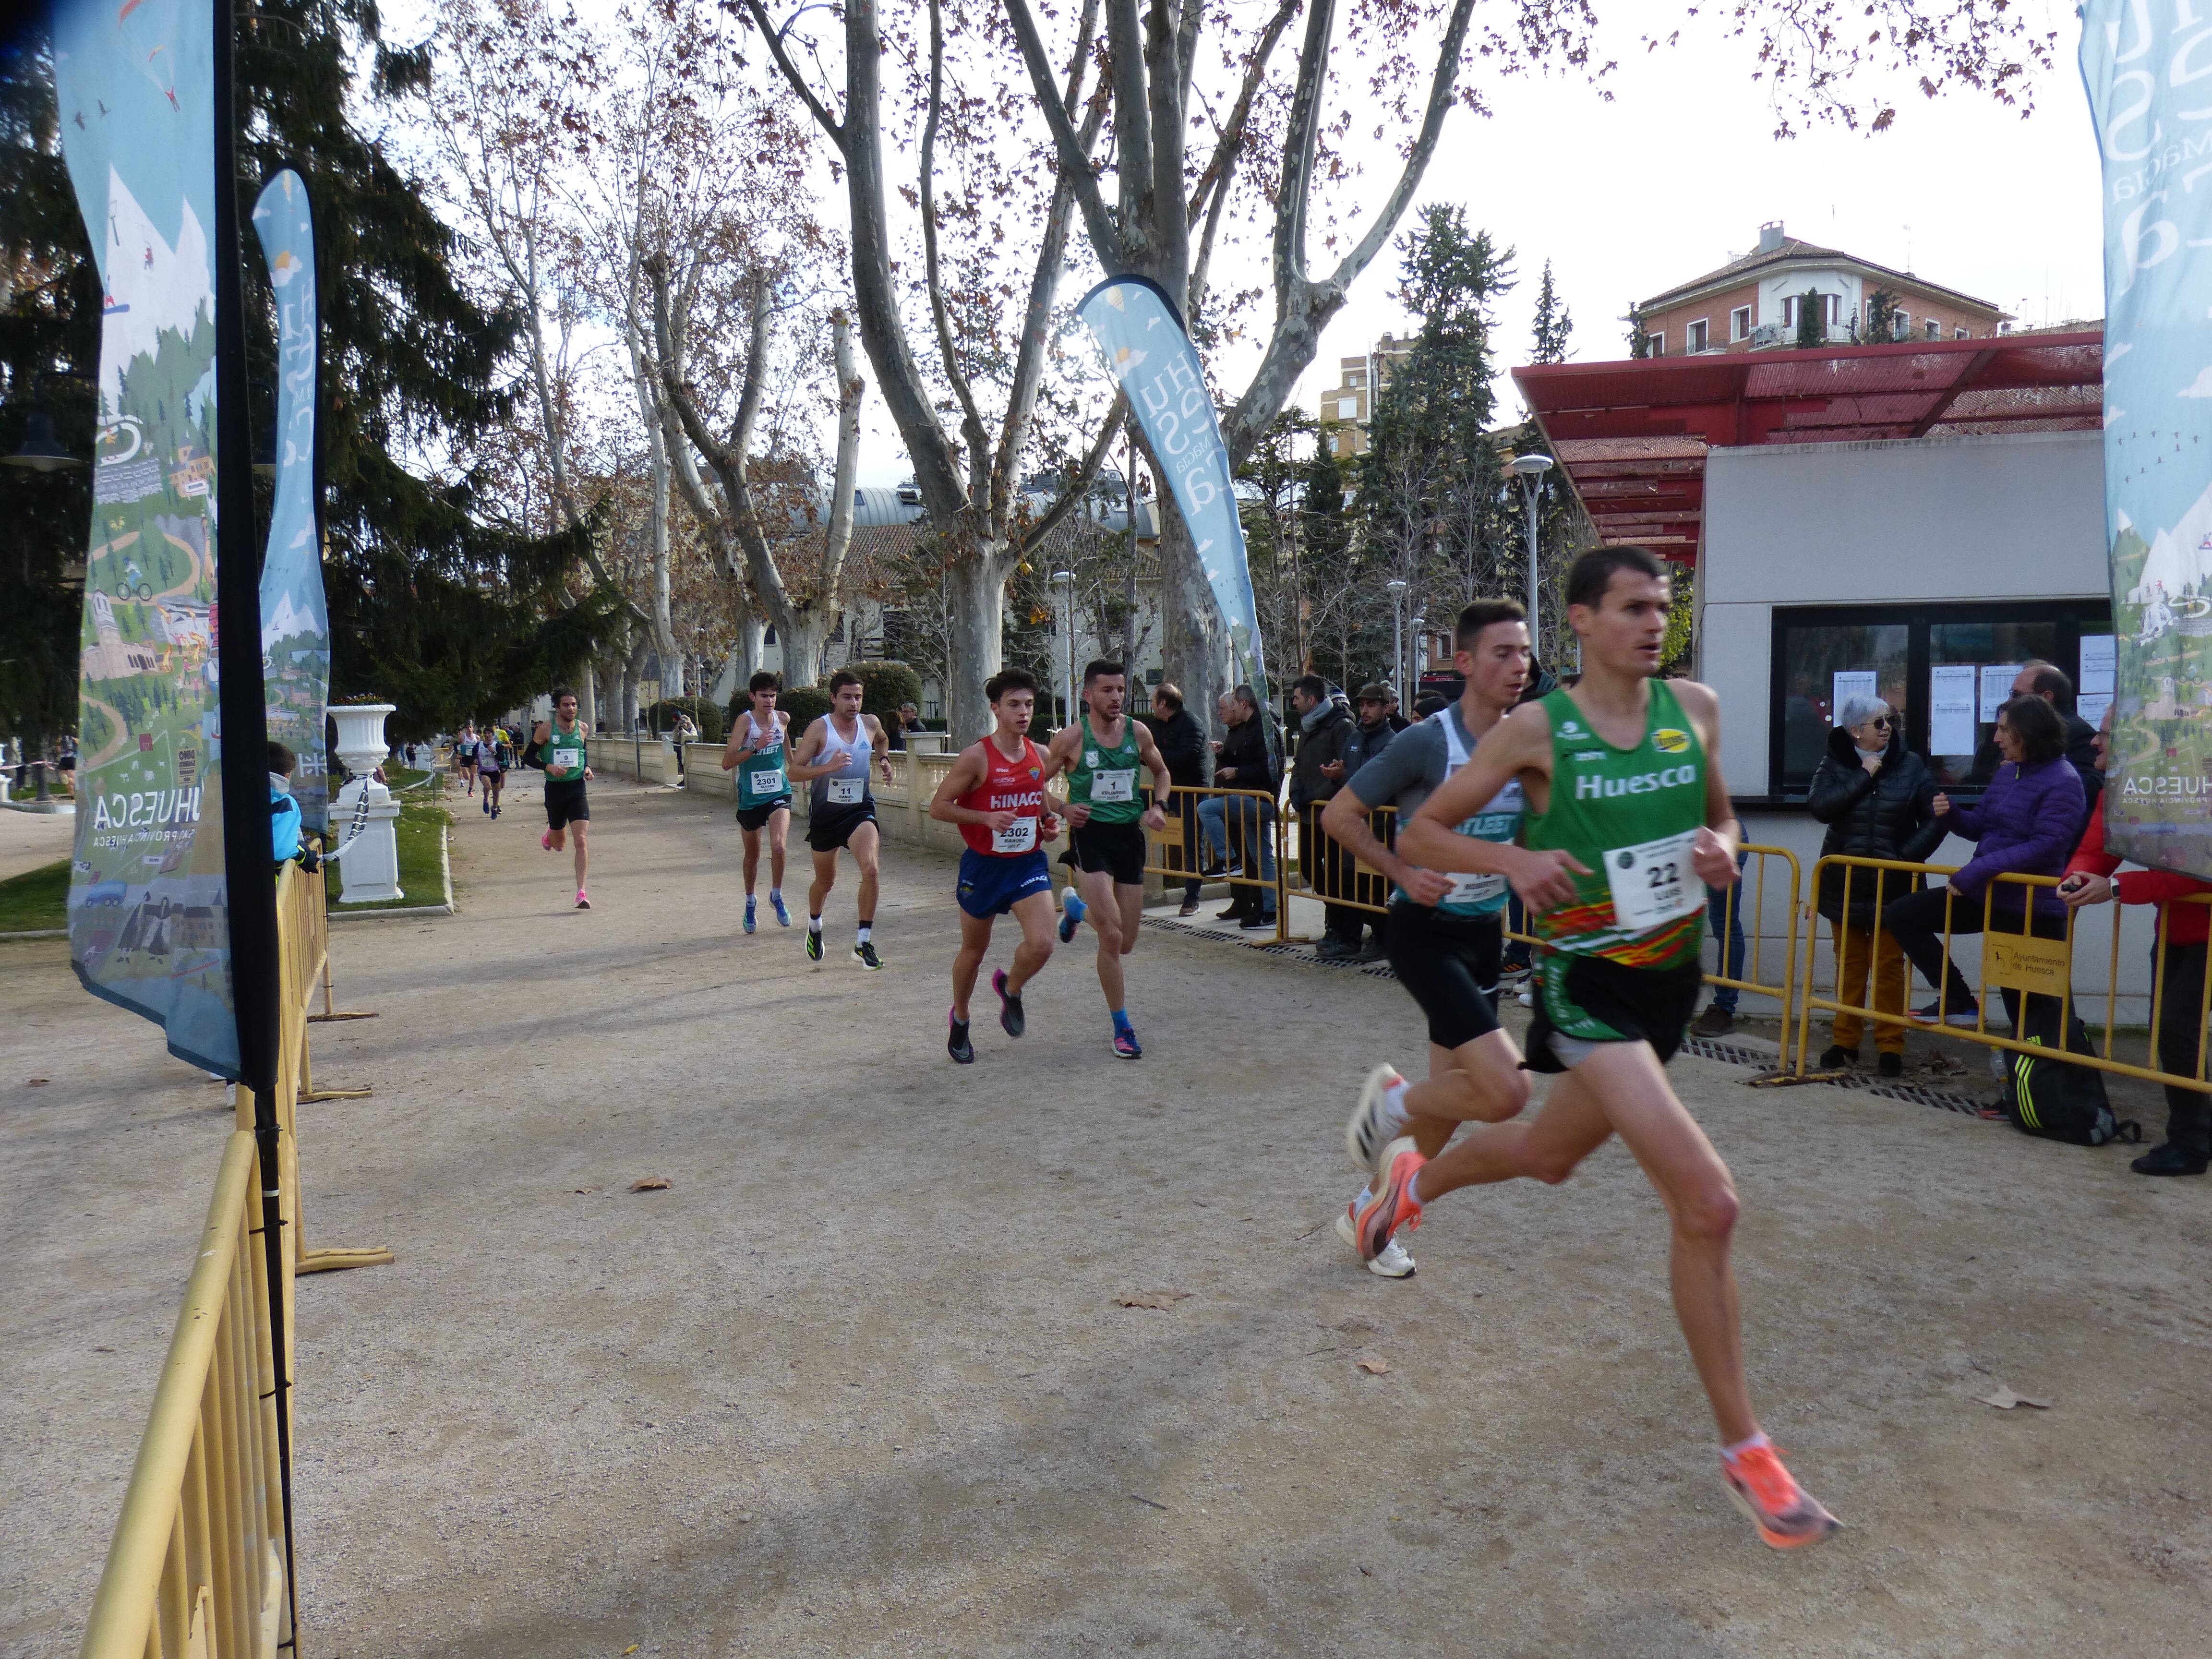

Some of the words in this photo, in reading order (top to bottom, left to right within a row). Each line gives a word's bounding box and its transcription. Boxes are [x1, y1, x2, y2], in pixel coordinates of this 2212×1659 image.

[757, 777, 776, 785] 2301
[1110, 781, 1116, 790] 1
[1575, 765, 1695, 800] Huesca
[1000, 827, 1028, 837] 2302
[1647, 862, 1679, 888] 22
[2014, 951, 2065, 968] Ayuntamiento
[2012, 962, 2022, 971] de
[2025, 964, 2055, 976] Huesca
